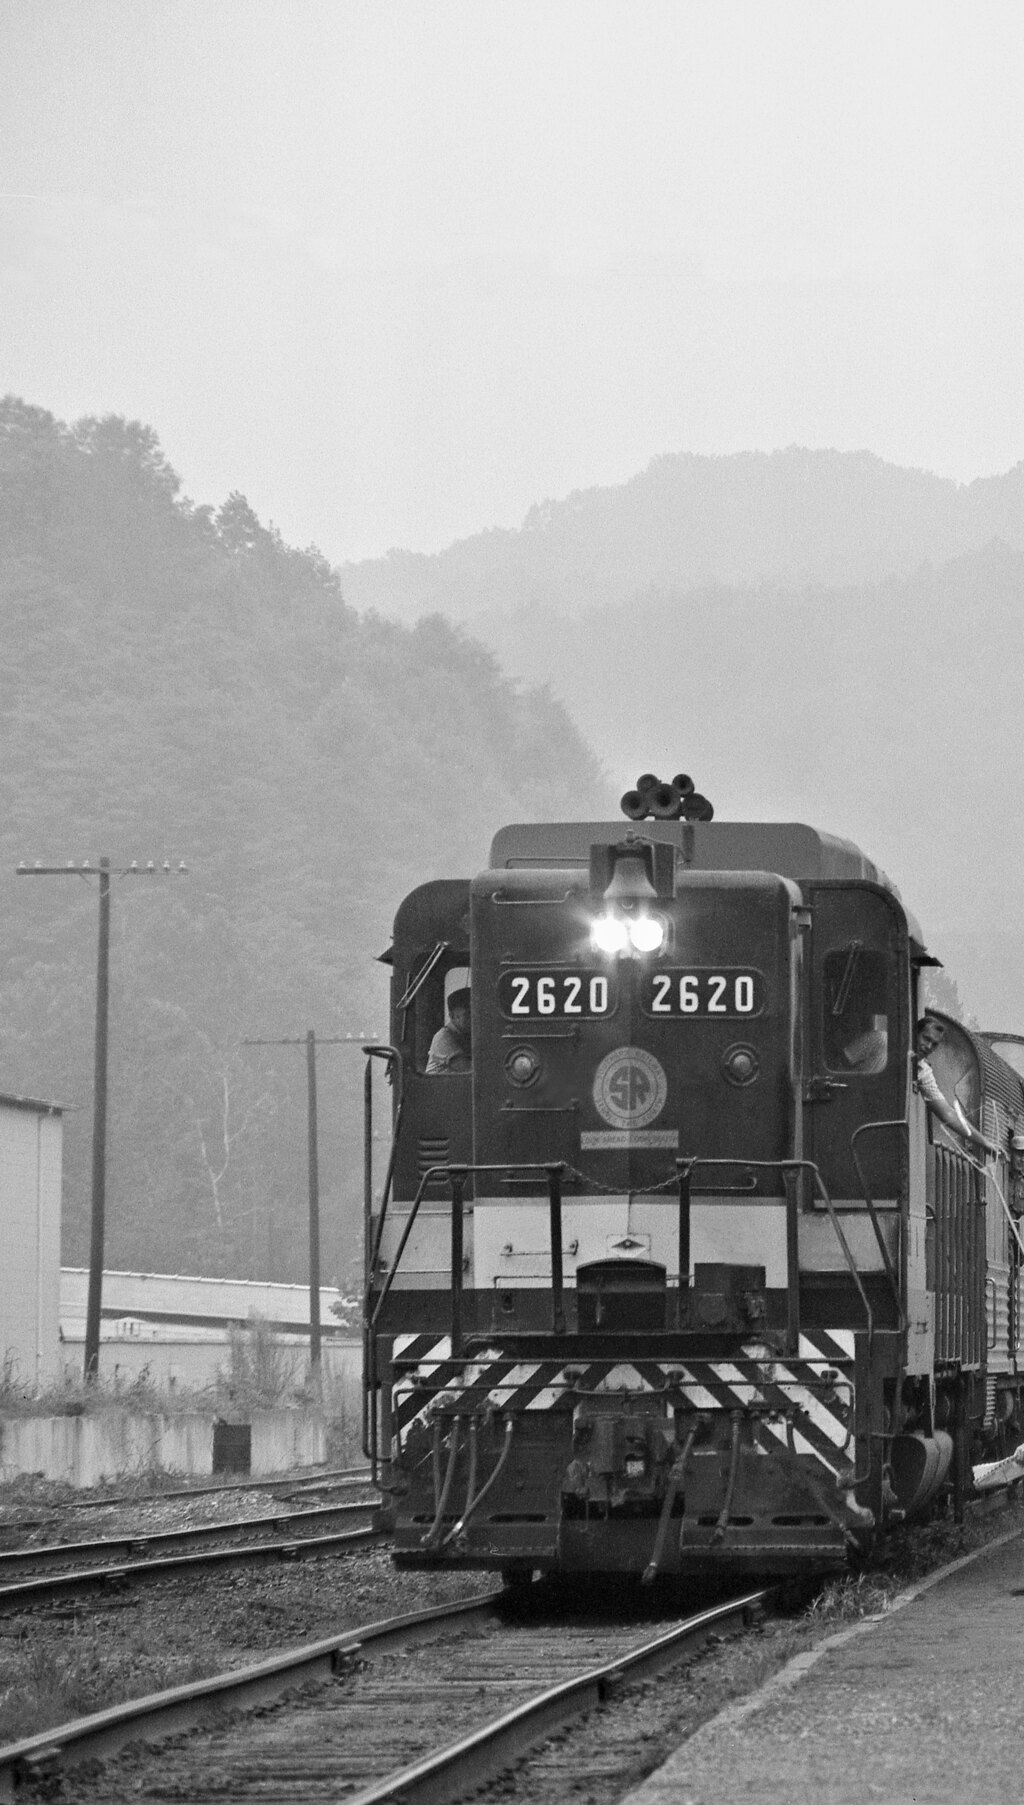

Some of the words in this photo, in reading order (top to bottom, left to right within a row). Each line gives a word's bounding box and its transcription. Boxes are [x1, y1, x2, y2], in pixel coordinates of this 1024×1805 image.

[511, 977, 608, 1014] 2620
[652, 975, 754, 1012] 2620
[608, 1066, 651, 1111] SR
